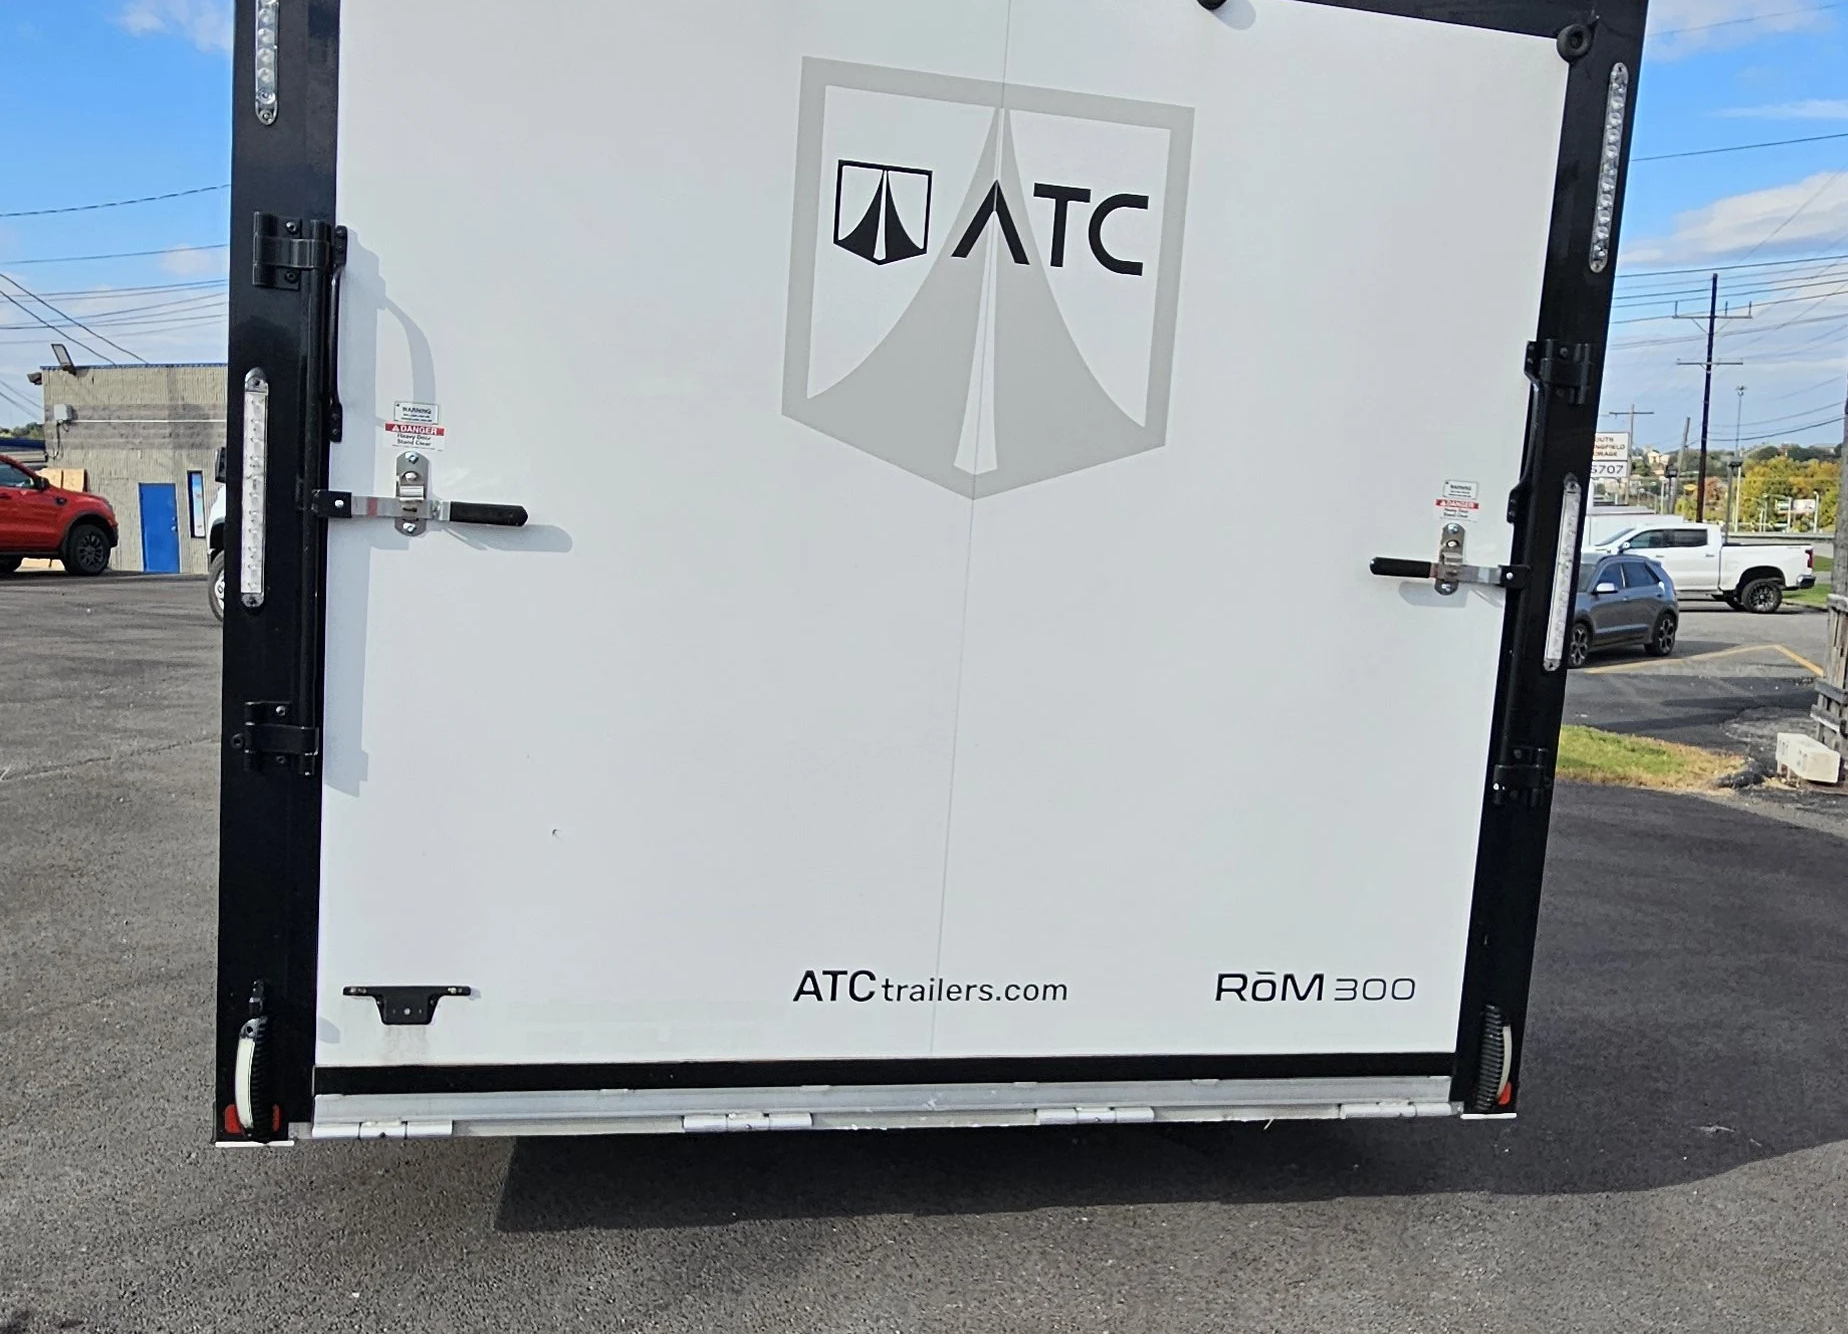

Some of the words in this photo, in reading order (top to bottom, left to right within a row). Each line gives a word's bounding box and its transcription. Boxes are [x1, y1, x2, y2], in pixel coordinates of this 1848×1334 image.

[951, 179, 1149, 276] ATC
[400, 425, 437, 435] DANGER
[1334, 978, 1416, 1001] 300
